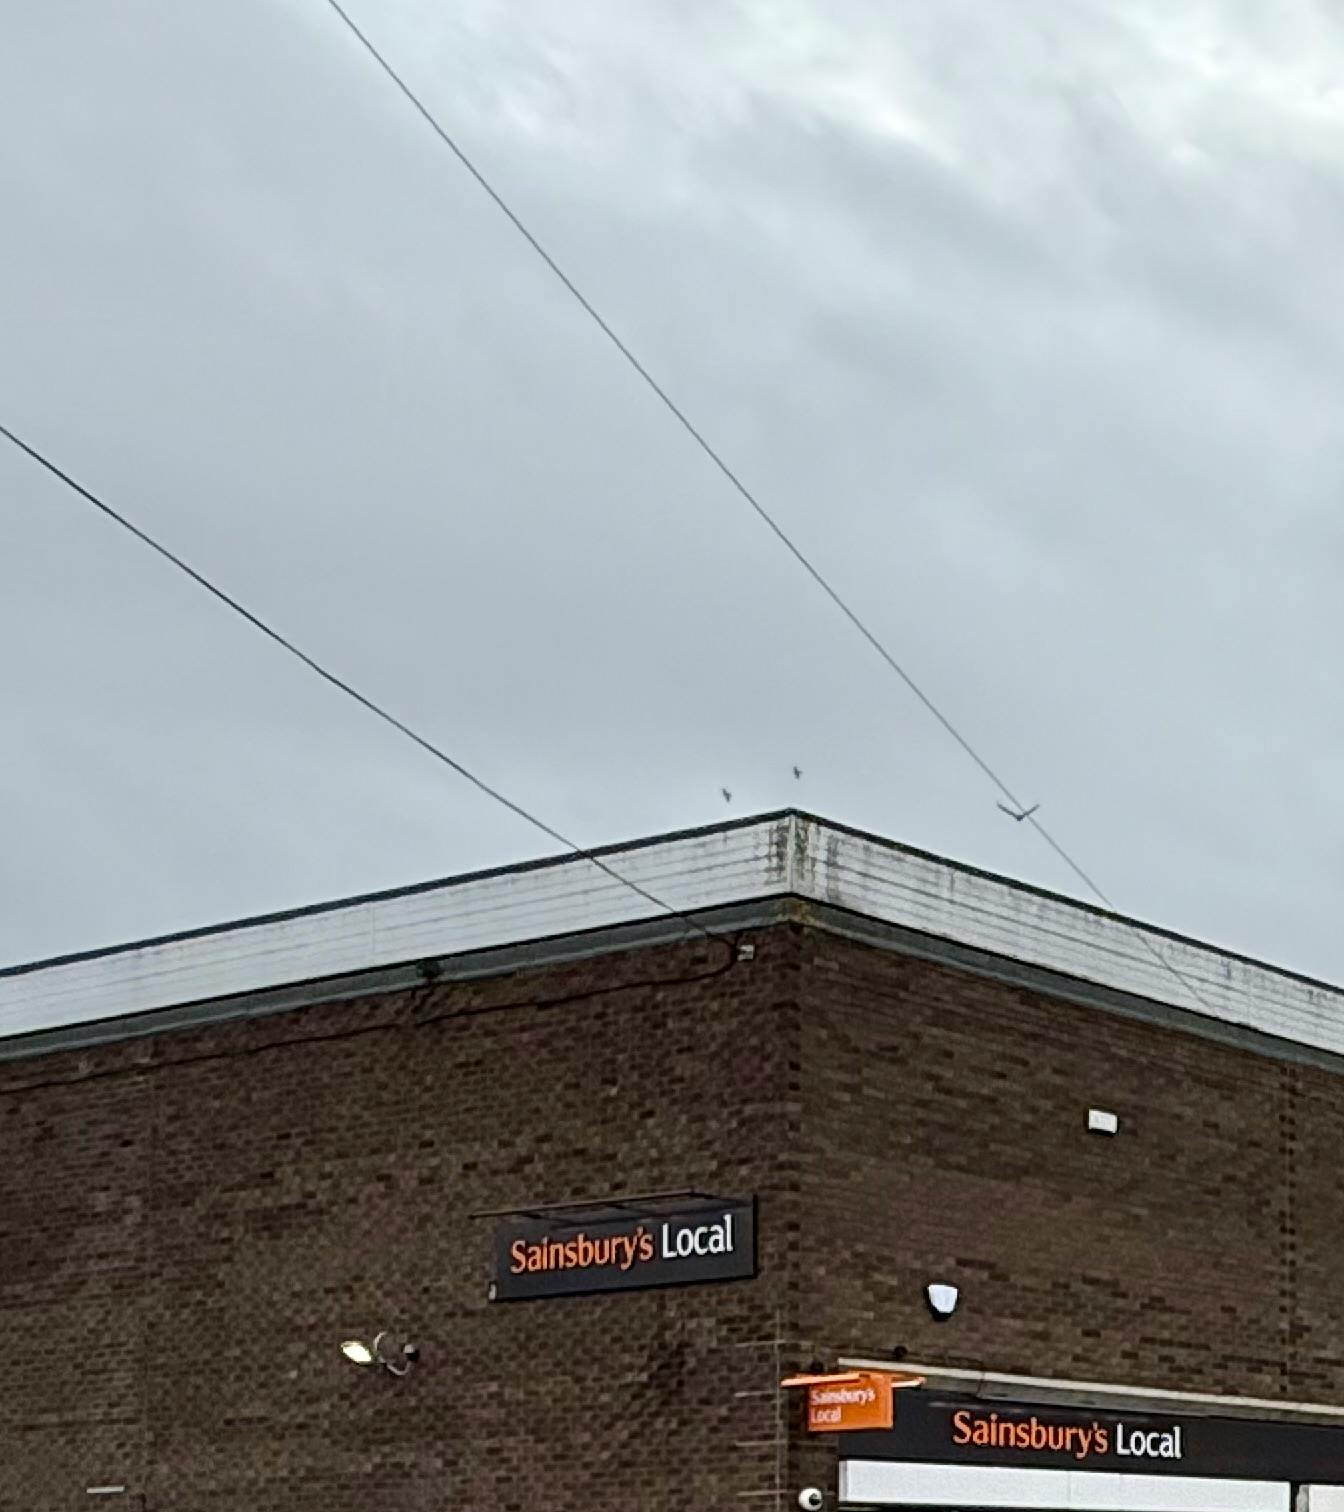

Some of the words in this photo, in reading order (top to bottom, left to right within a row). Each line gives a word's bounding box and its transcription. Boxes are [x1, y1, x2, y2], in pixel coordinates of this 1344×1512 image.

[510, 1225, 654, 1274] Sainsbury's
[661, 1213, 734, 1259] Local
[952, 1410, 1109, 1459] Sainsbury's
[1116, 1423, 1183, 1459] Local
